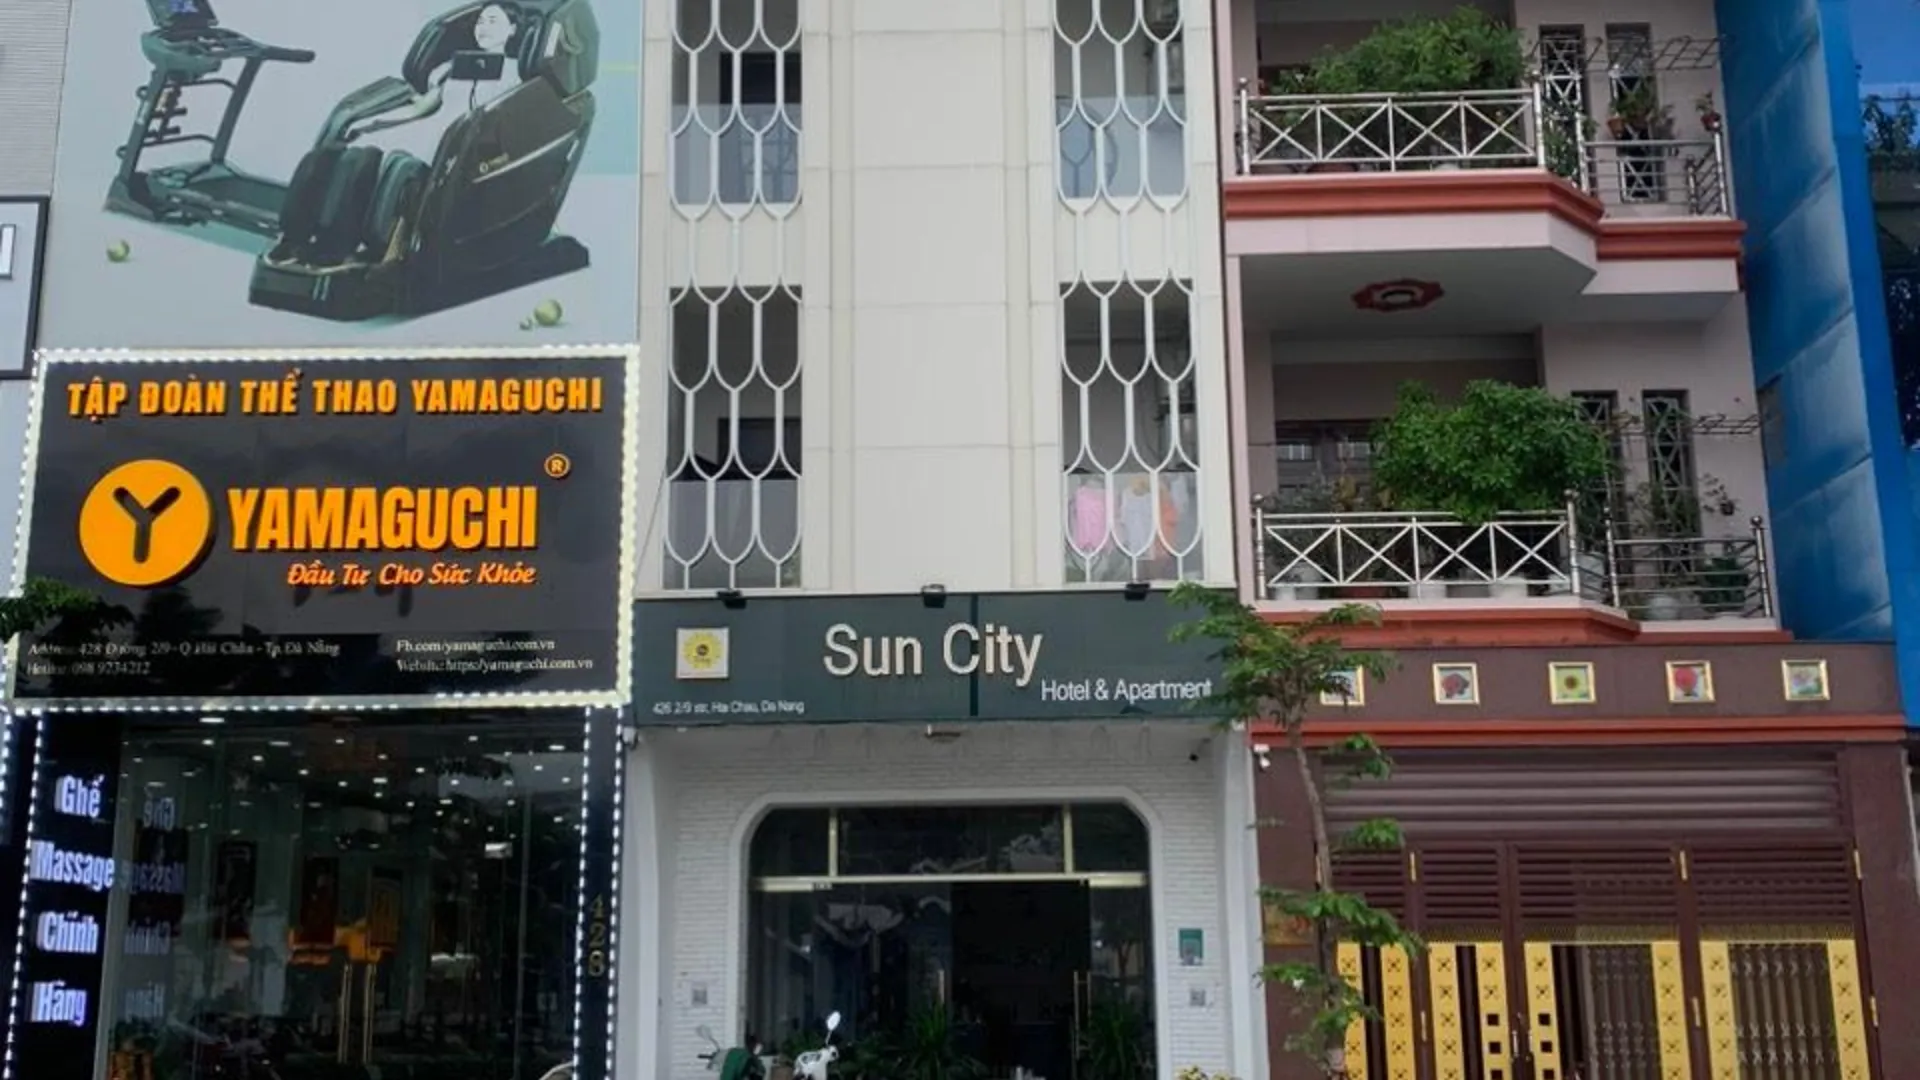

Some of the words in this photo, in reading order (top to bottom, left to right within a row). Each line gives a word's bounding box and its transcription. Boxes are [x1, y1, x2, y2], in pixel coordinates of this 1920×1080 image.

[68, 376, 127, 421] TẬP
[140, 374, 226, 413] ĐOÀN
[241, 368, 303, 413] THỂ
[312, 379, 397, 413] THAO
[411, 377, 602, 412] YAMAGUCHI
[228, 487, 537, 550] YAMAGUCHI
[288, 560, 335, 585] Đầu
[343, 564, 371, 585] Tư
[380, 562, 424, 585] Cho
[428, 562, 472, 584] Sức
[478, 561, 537, 584] Khỏe
[823, 623, 922, 676] Sun
[942, 622, 1043, 687] City
[1041, 678, 1091, 701] Hotel
[1095, 678, 1109, 700] &
[1113, 678, 1213, 704] Apartment
[54, 774, 104, 818] Ghế
[31, 840, 115, 891] Massage
[38, 911, 99, 954] Chính
[32, 980, 87, 1026] Hãng
